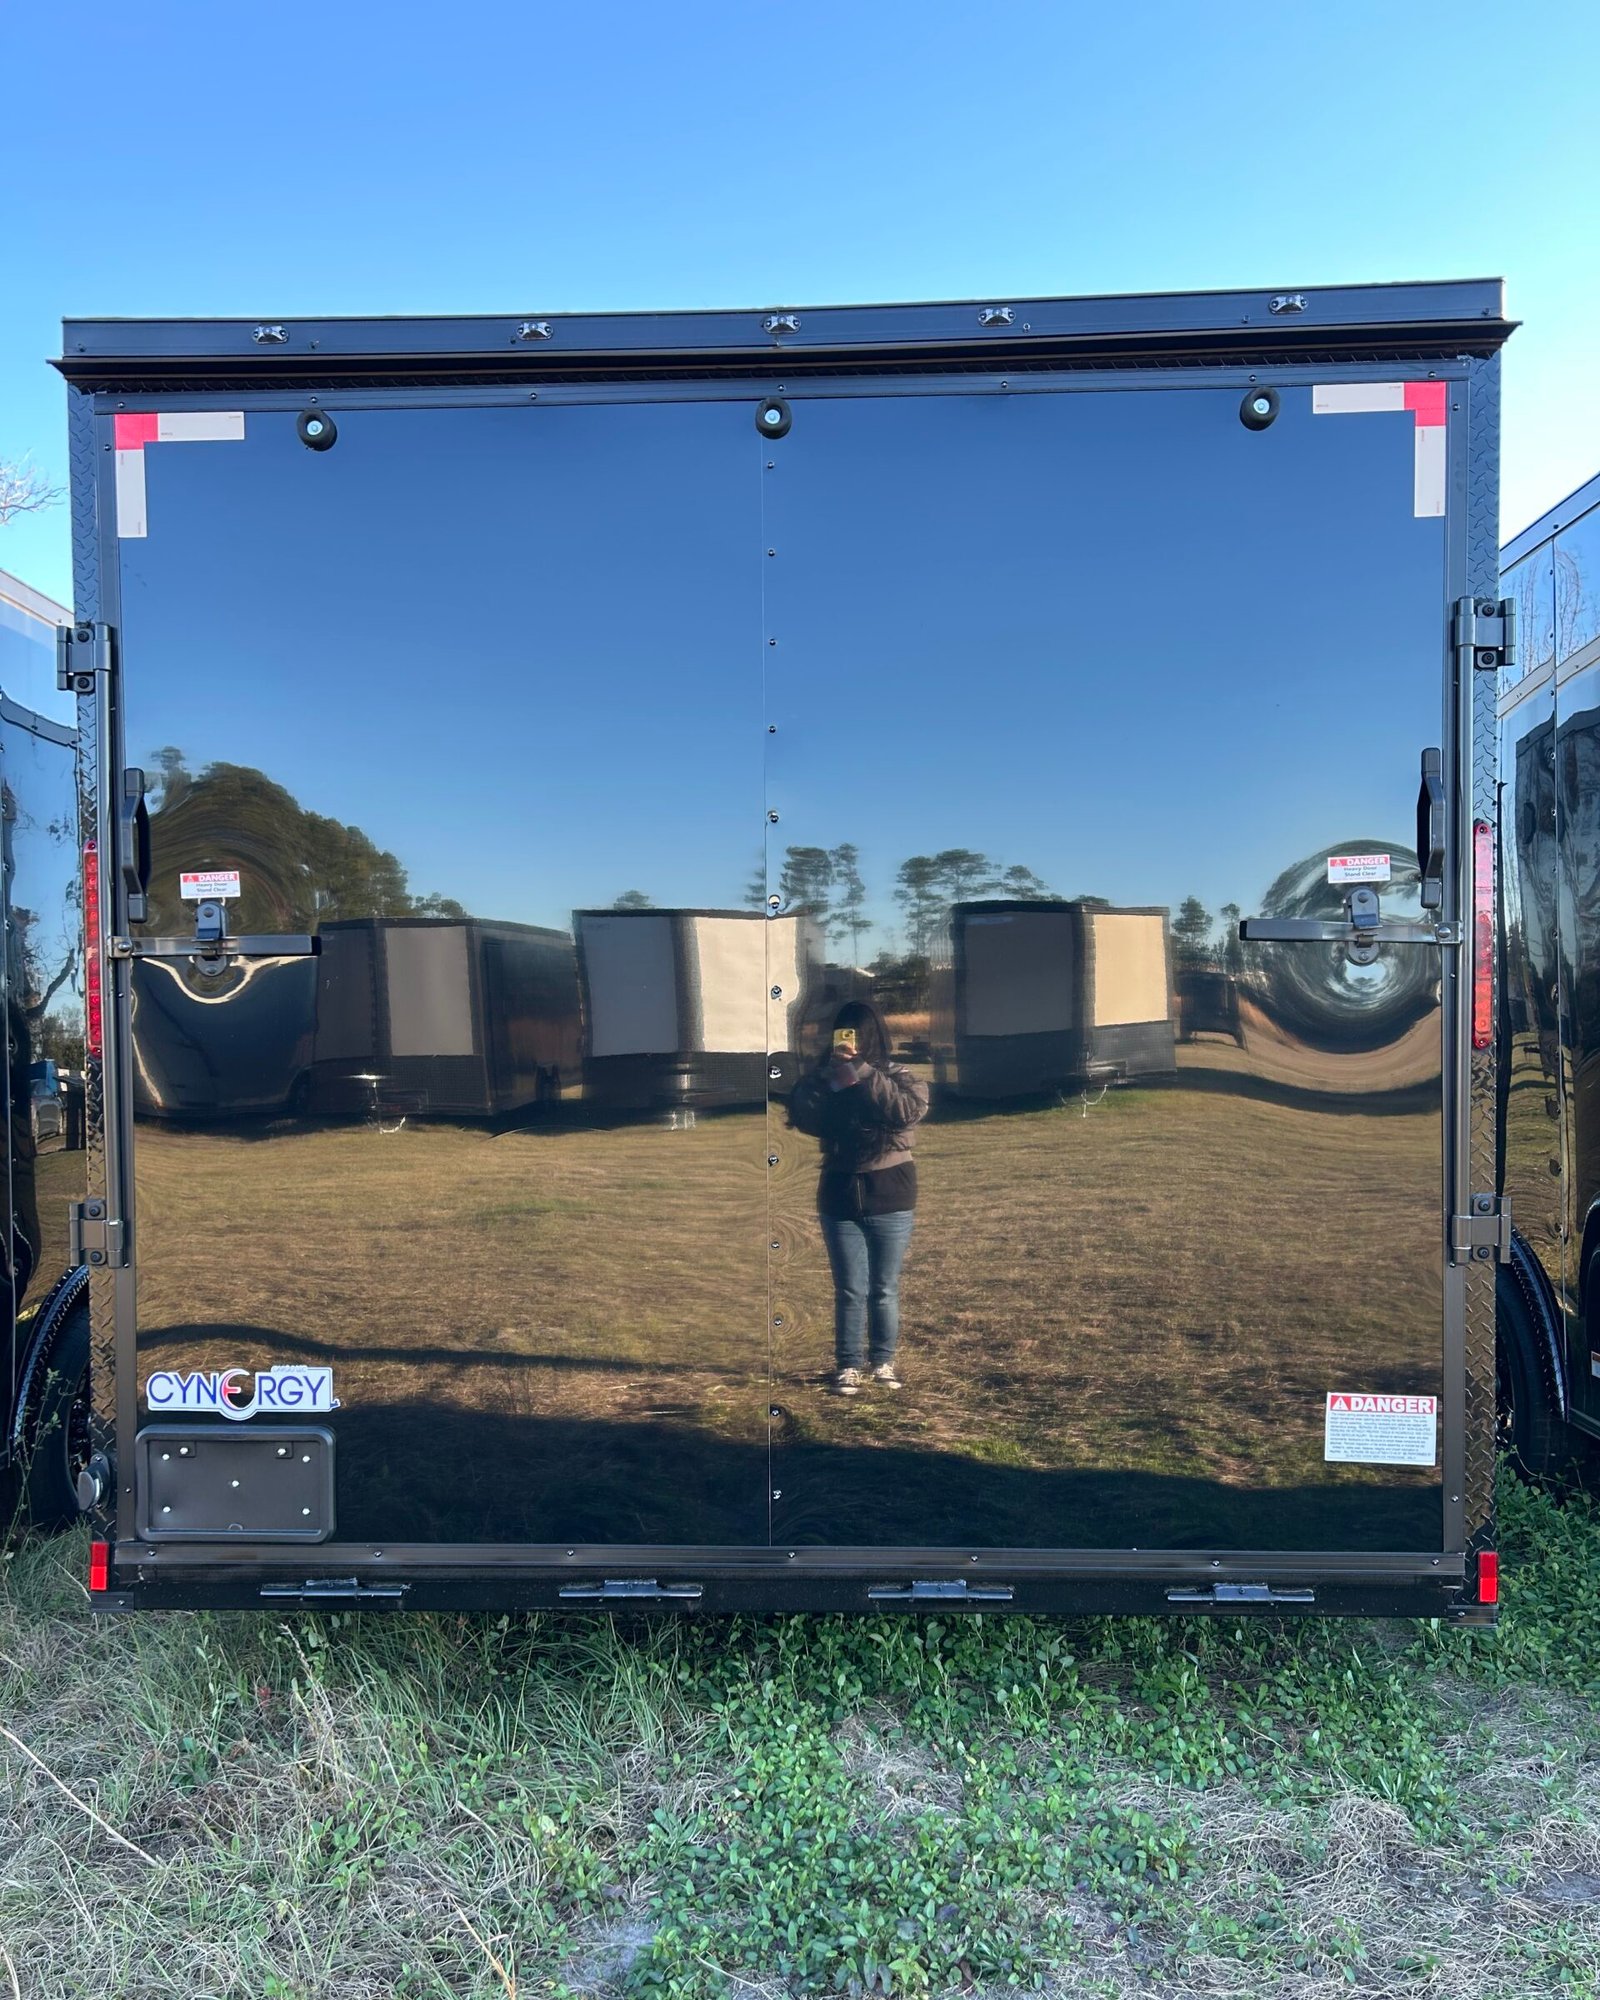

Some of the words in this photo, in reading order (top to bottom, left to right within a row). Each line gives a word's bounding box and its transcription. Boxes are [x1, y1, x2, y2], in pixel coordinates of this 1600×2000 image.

[1347, 857, 1385, 866] DANGER
[198, 873, 235, 882] DANGER
[149, 1371, 326, 1412] CYNERGY
[1351, 1397, 1431, 1413] DANGER
